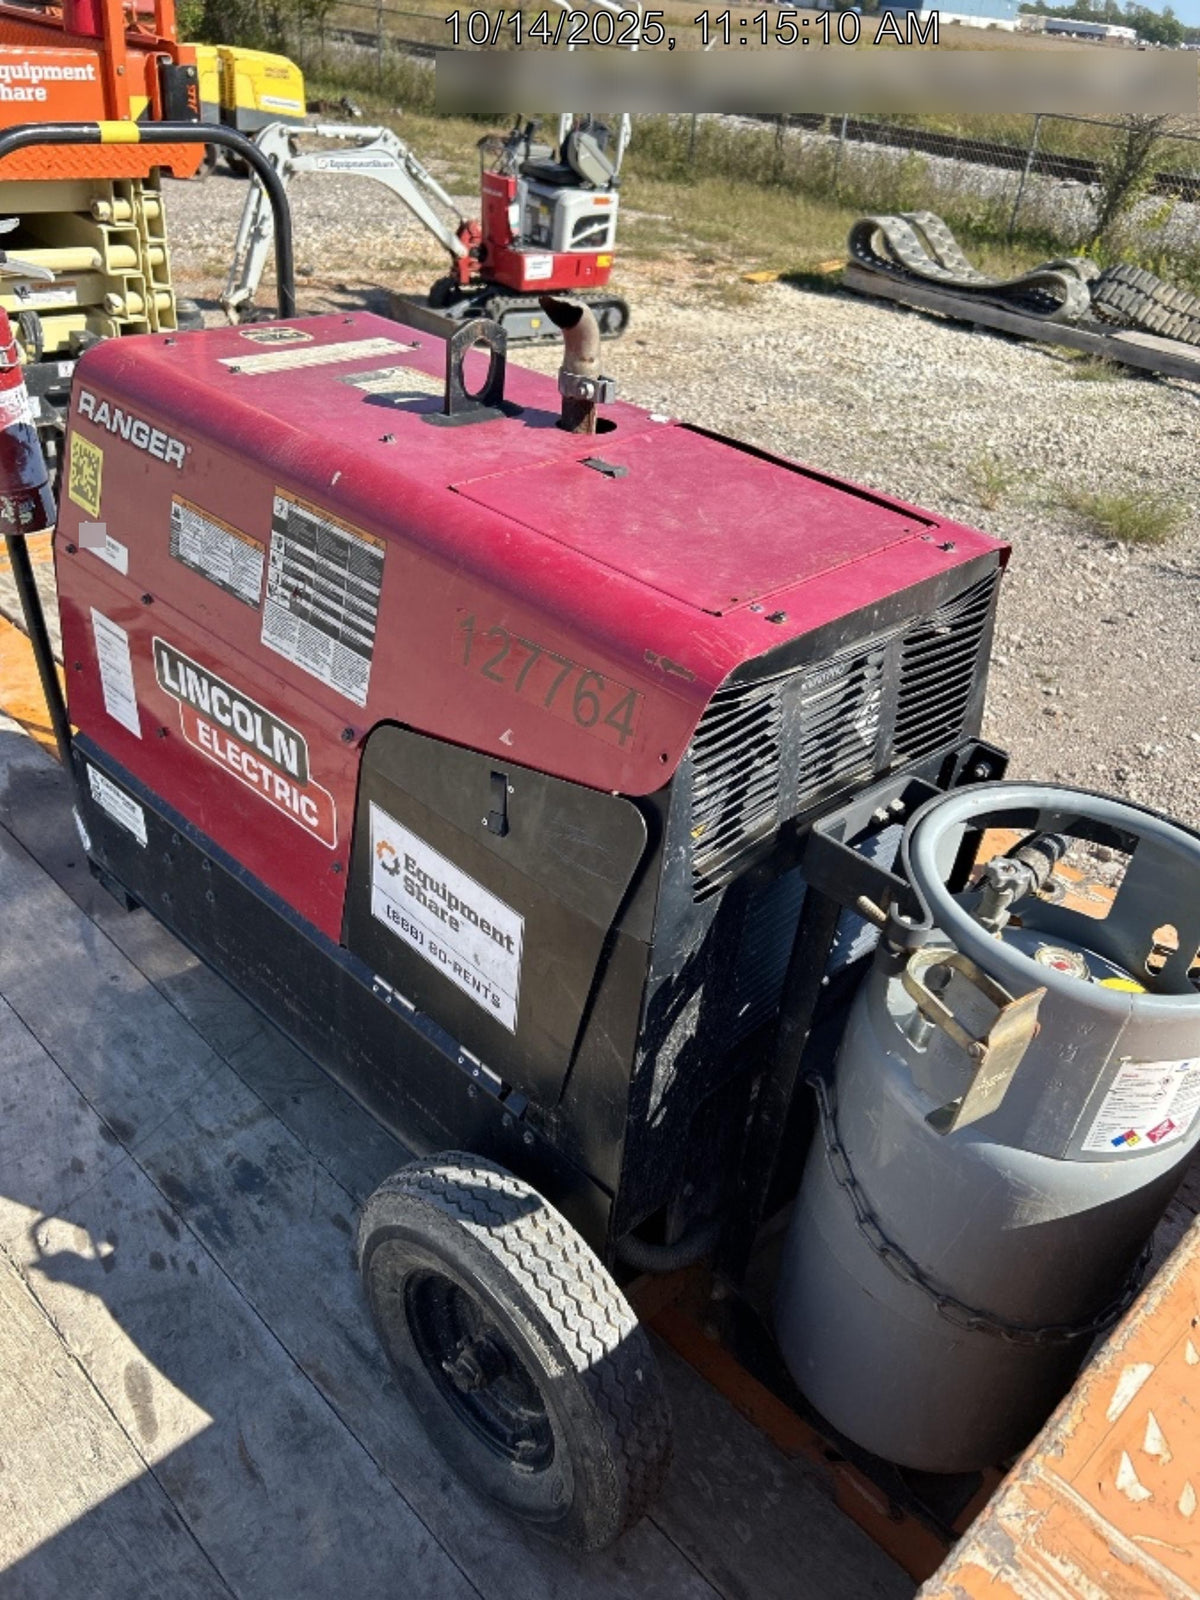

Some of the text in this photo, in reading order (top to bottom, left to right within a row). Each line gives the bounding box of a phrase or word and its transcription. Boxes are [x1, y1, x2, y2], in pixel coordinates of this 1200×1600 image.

[77, 389, 187, 470] RANGER
[160, 650, 301, 778] LINCOLN
[459, 614, 637, 748] 127764
[196, 717, 320, 828] ELECTRIC
[403, 874, 461, 933] Share
[403, 852, 515, 956] Equipment
[428, 941, 503, 1010] 80-RENTS
